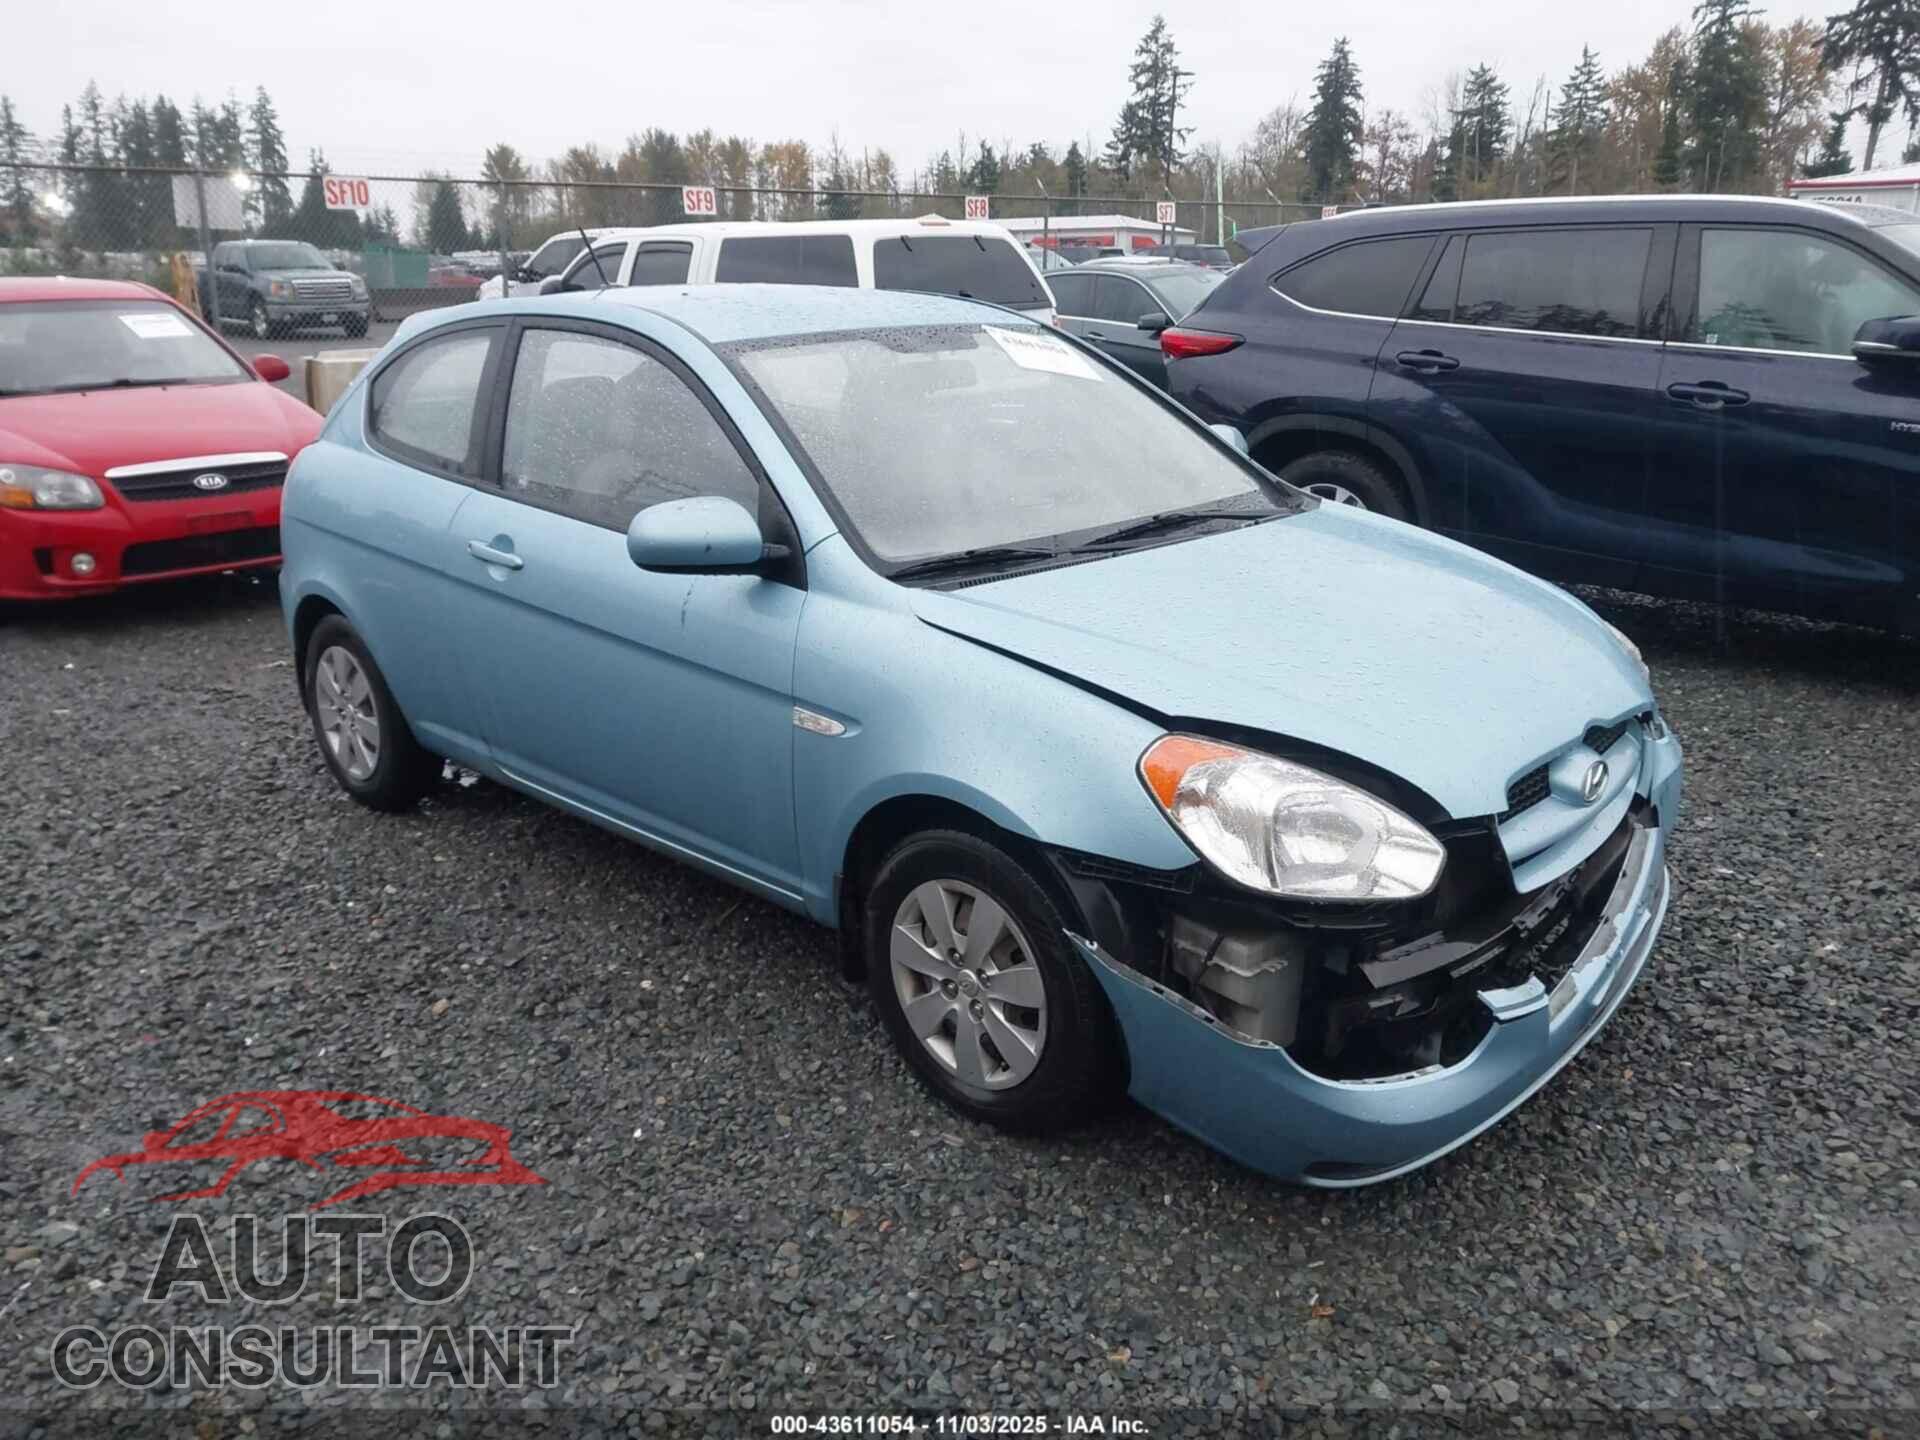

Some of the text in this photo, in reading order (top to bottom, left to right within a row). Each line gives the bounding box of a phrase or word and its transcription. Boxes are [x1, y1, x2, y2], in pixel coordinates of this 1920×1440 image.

[325, 179, 369, 206] SF10
[685, 190, 714, 212] SF9
[967, 199, 987, 217] SF8
[1158, 204, 1174, 222] SF7
[200, 477, 225, 487] KIA
